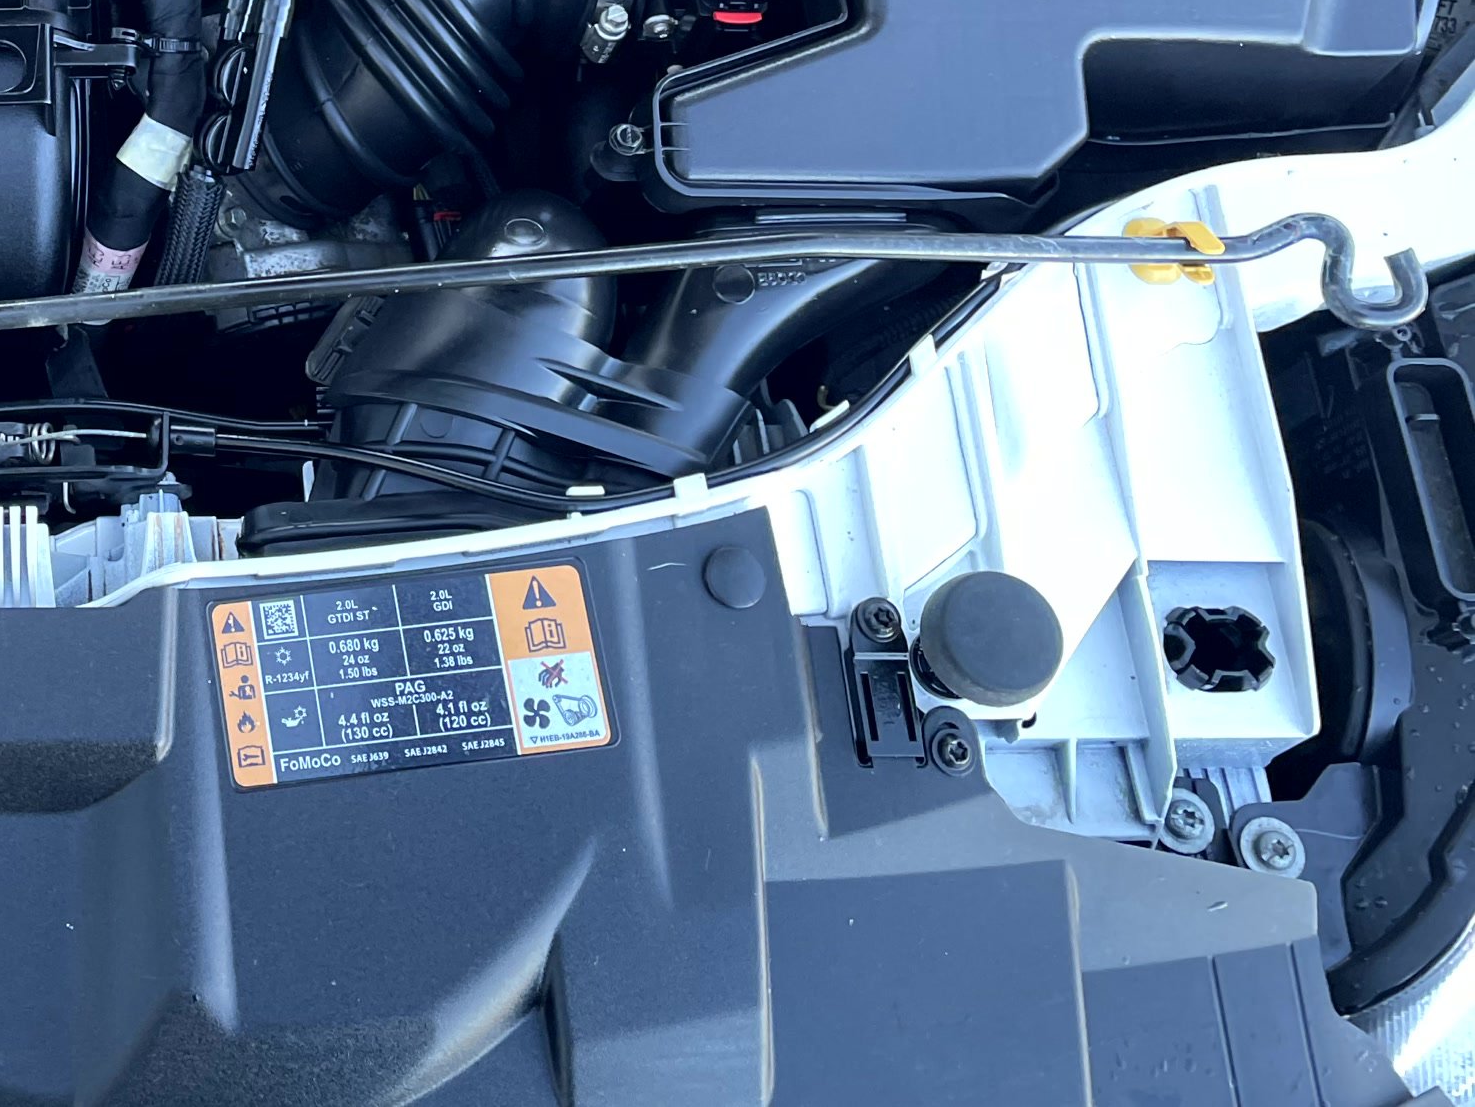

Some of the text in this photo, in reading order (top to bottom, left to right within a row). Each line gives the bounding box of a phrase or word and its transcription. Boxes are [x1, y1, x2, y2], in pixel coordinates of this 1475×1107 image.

[430, 589, 453, 601] 2.0L
[335, 600, 359, 611] 2.0L
[433, 601, 453, 612] GDI
[327, 610, 370, 624] GTDI ST
[423, 626, 475, 643] 0.625 kg
[328, 637, 380, 654] 0.680 kg
[437, 643, 466, 655] 22 oz
[342, 655, 370, 666] 24 oz
[434, 655, 474, 669] 1.38 lbs
[265, 671, 310, 685] R-1234yf
[339, 666, 379, 680] 1.50 lbs
[395, 680, 426, 696] PAG
[370, 690, 454, 709] WSS-M2C300-A2
[436, 700, 488, 716] 4.1 fl oz
[338, 711, 390, 727] 4.4 fl oz
[439, 712, 492, 733] (120 cc)
[341, 723, 393, 744] (130 cc)
[279, 737, 506, 773] FoMoCo SAE J639 SAE J2842 SAE J2845
